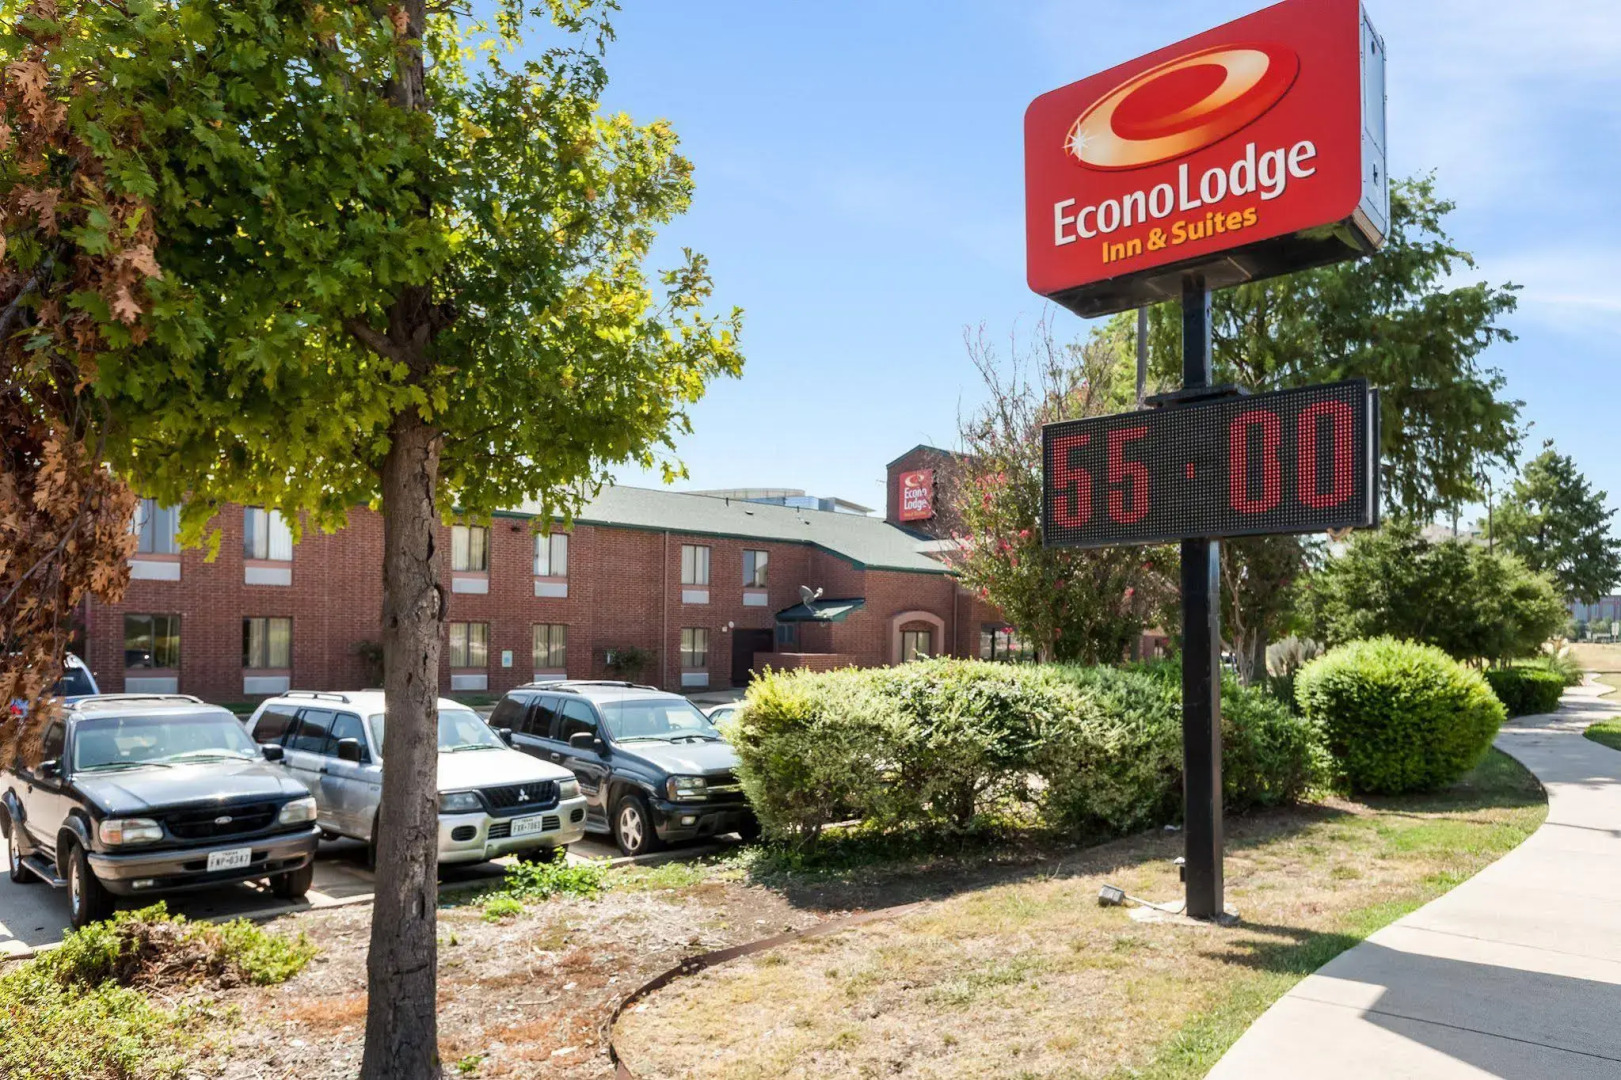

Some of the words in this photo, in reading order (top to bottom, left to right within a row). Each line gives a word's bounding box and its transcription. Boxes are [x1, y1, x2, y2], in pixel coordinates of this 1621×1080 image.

[1054, 139, 1317, 246] EconoLodge
[1102, 237, 1142, 264] Inn
[1147, 227, 1167, 251] &
[1171, 207, 1258, 245] Suites
